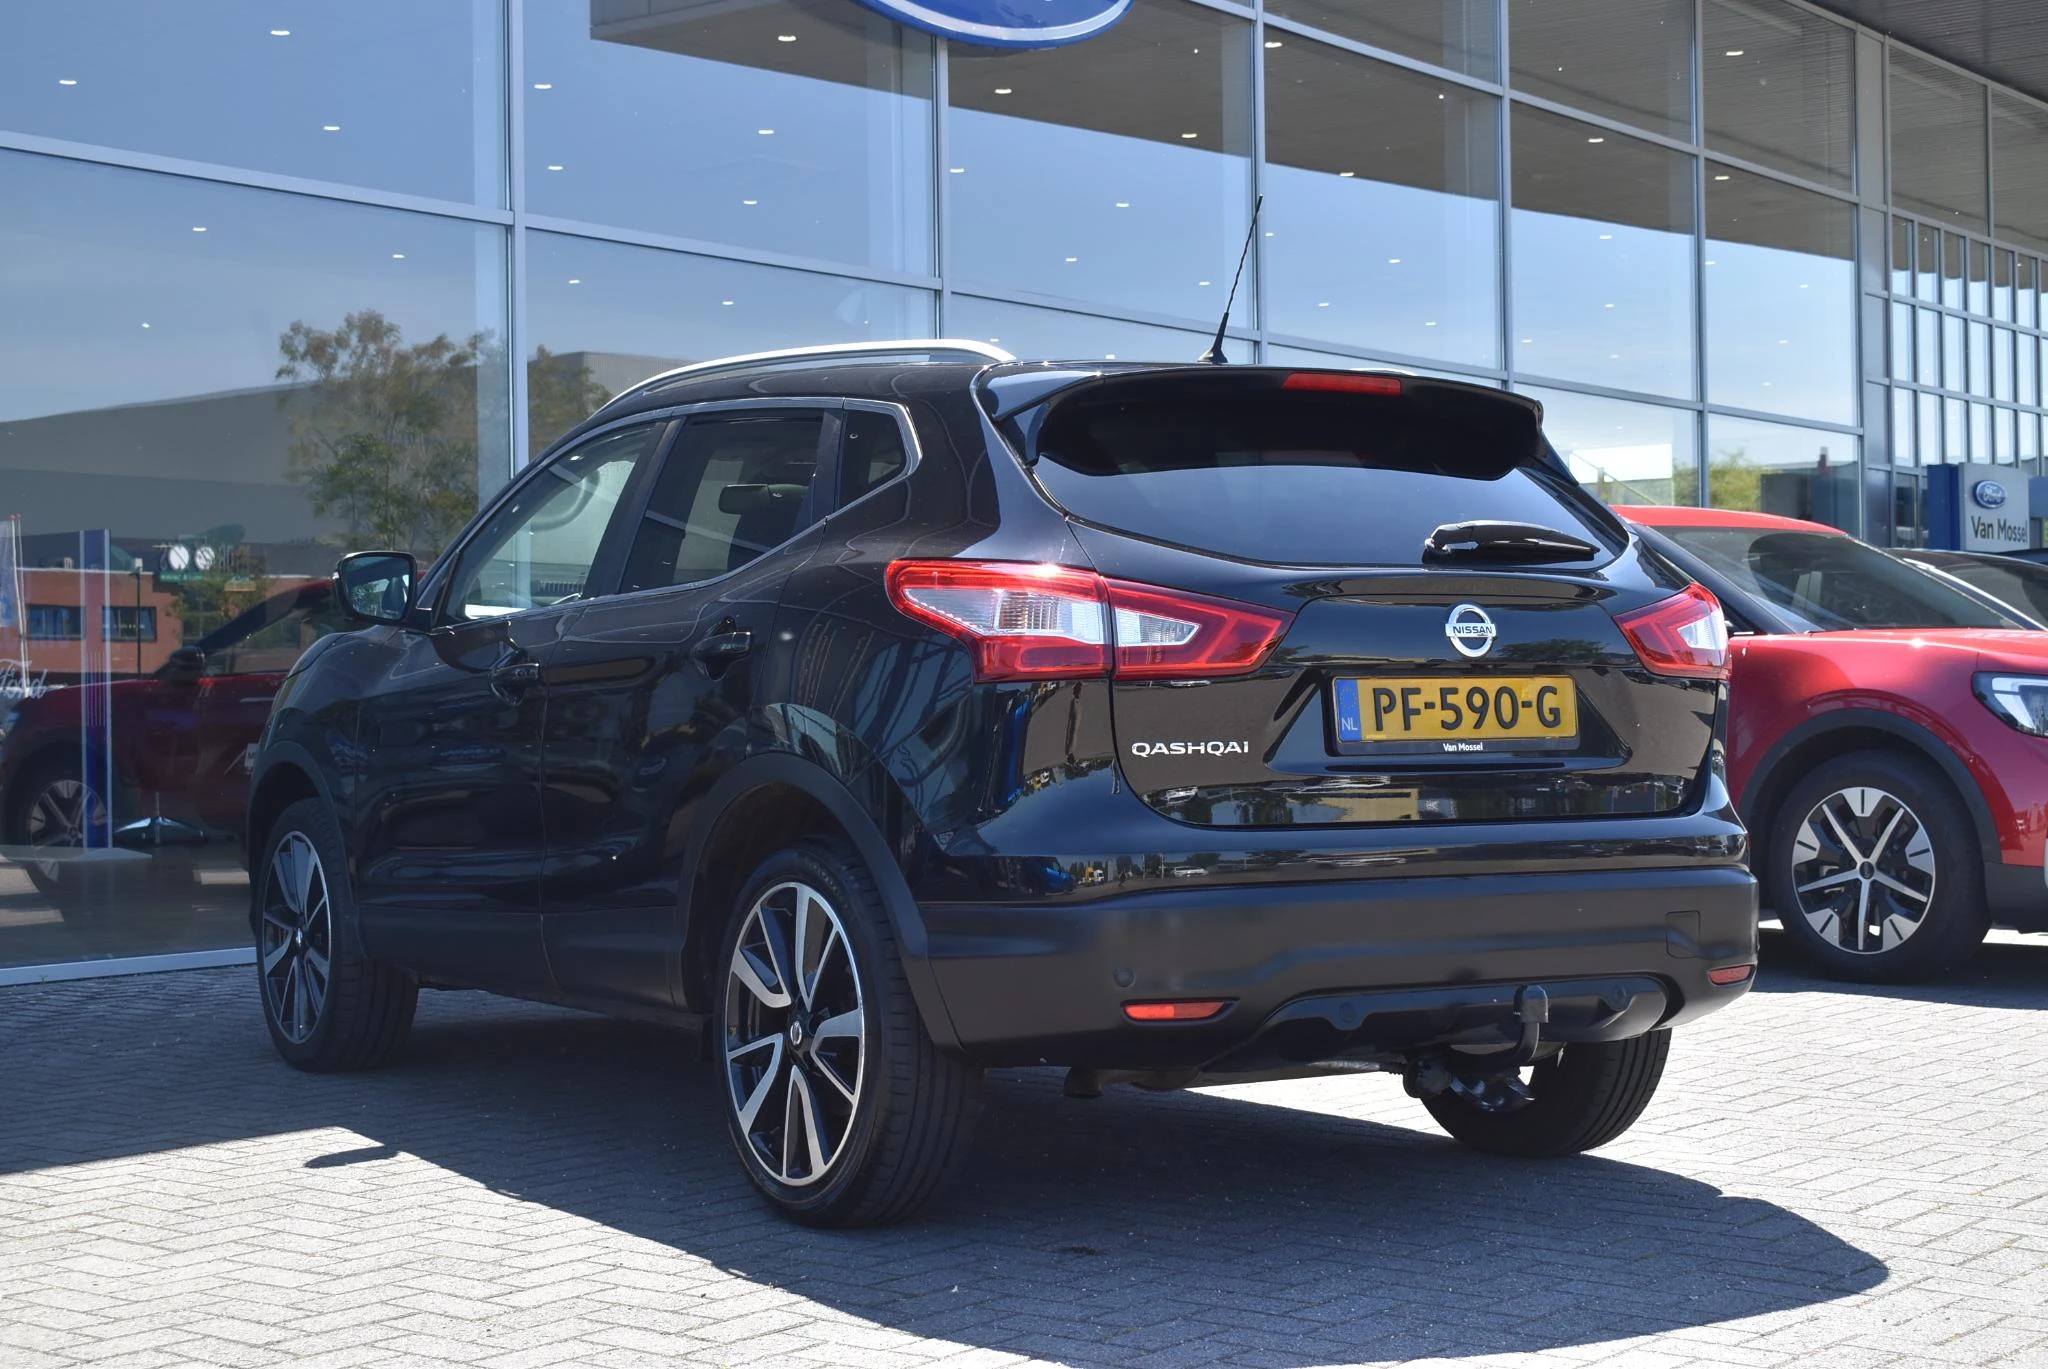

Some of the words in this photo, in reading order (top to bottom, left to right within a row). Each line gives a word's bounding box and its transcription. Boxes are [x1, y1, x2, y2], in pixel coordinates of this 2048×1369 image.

[1971, 516, 1994, 540] Van
[1997, 518, 2028, 543] Mossel
[1452, 625, 1493, 634] NISSAN
[1372, 685, 1562, 732] PF-590-G
[1341, 717, 1359, 731] NL
[1131, 740, 1249, 758] QASHQAI
[1442, 742, 1457, 752] Van
[1458, 741, 1484, 751] Mossel
